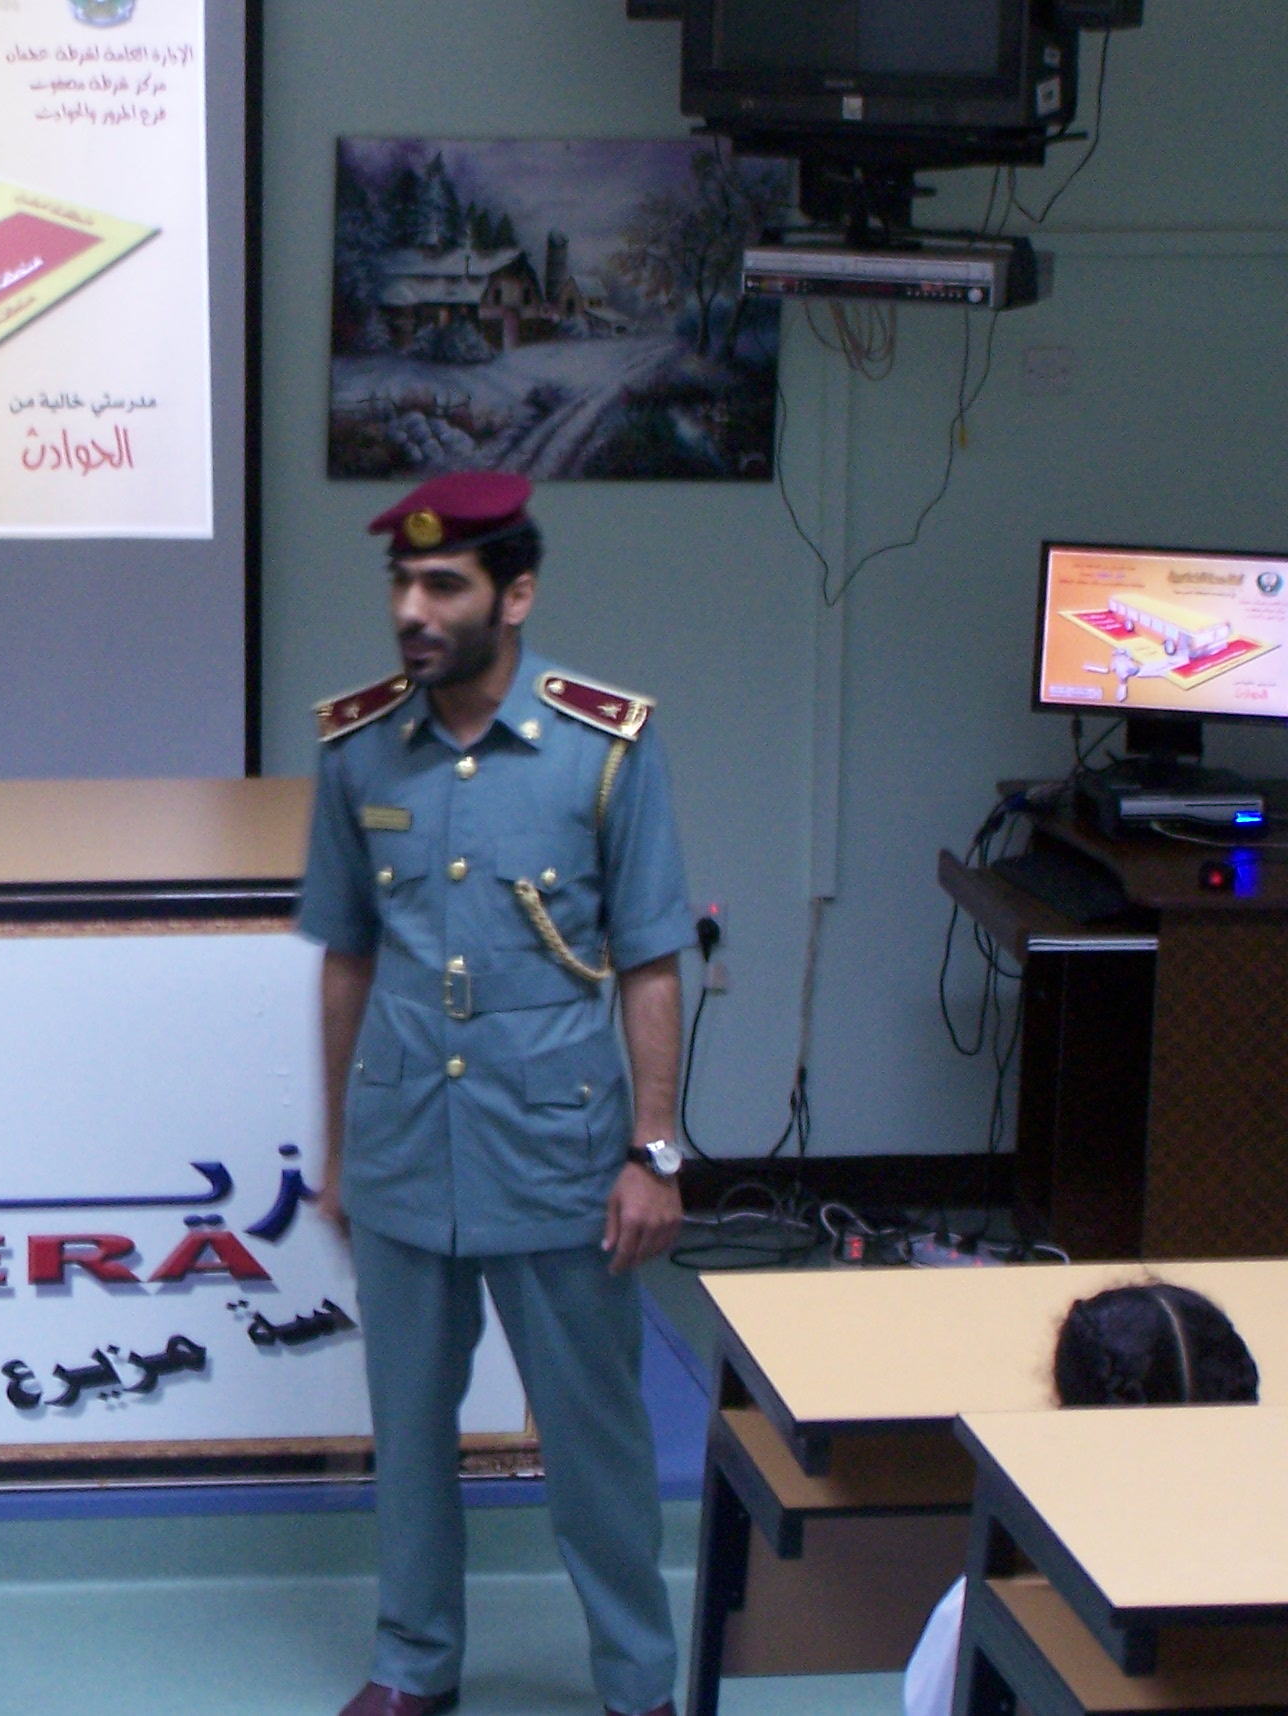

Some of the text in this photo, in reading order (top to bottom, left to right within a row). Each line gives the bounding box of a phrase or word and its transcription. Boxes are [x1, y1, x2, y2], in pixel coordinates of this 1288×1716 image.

[9, 391, 157, 418] مدرستي خالية من
[1, 1333, 207, 1409] مزيرع
